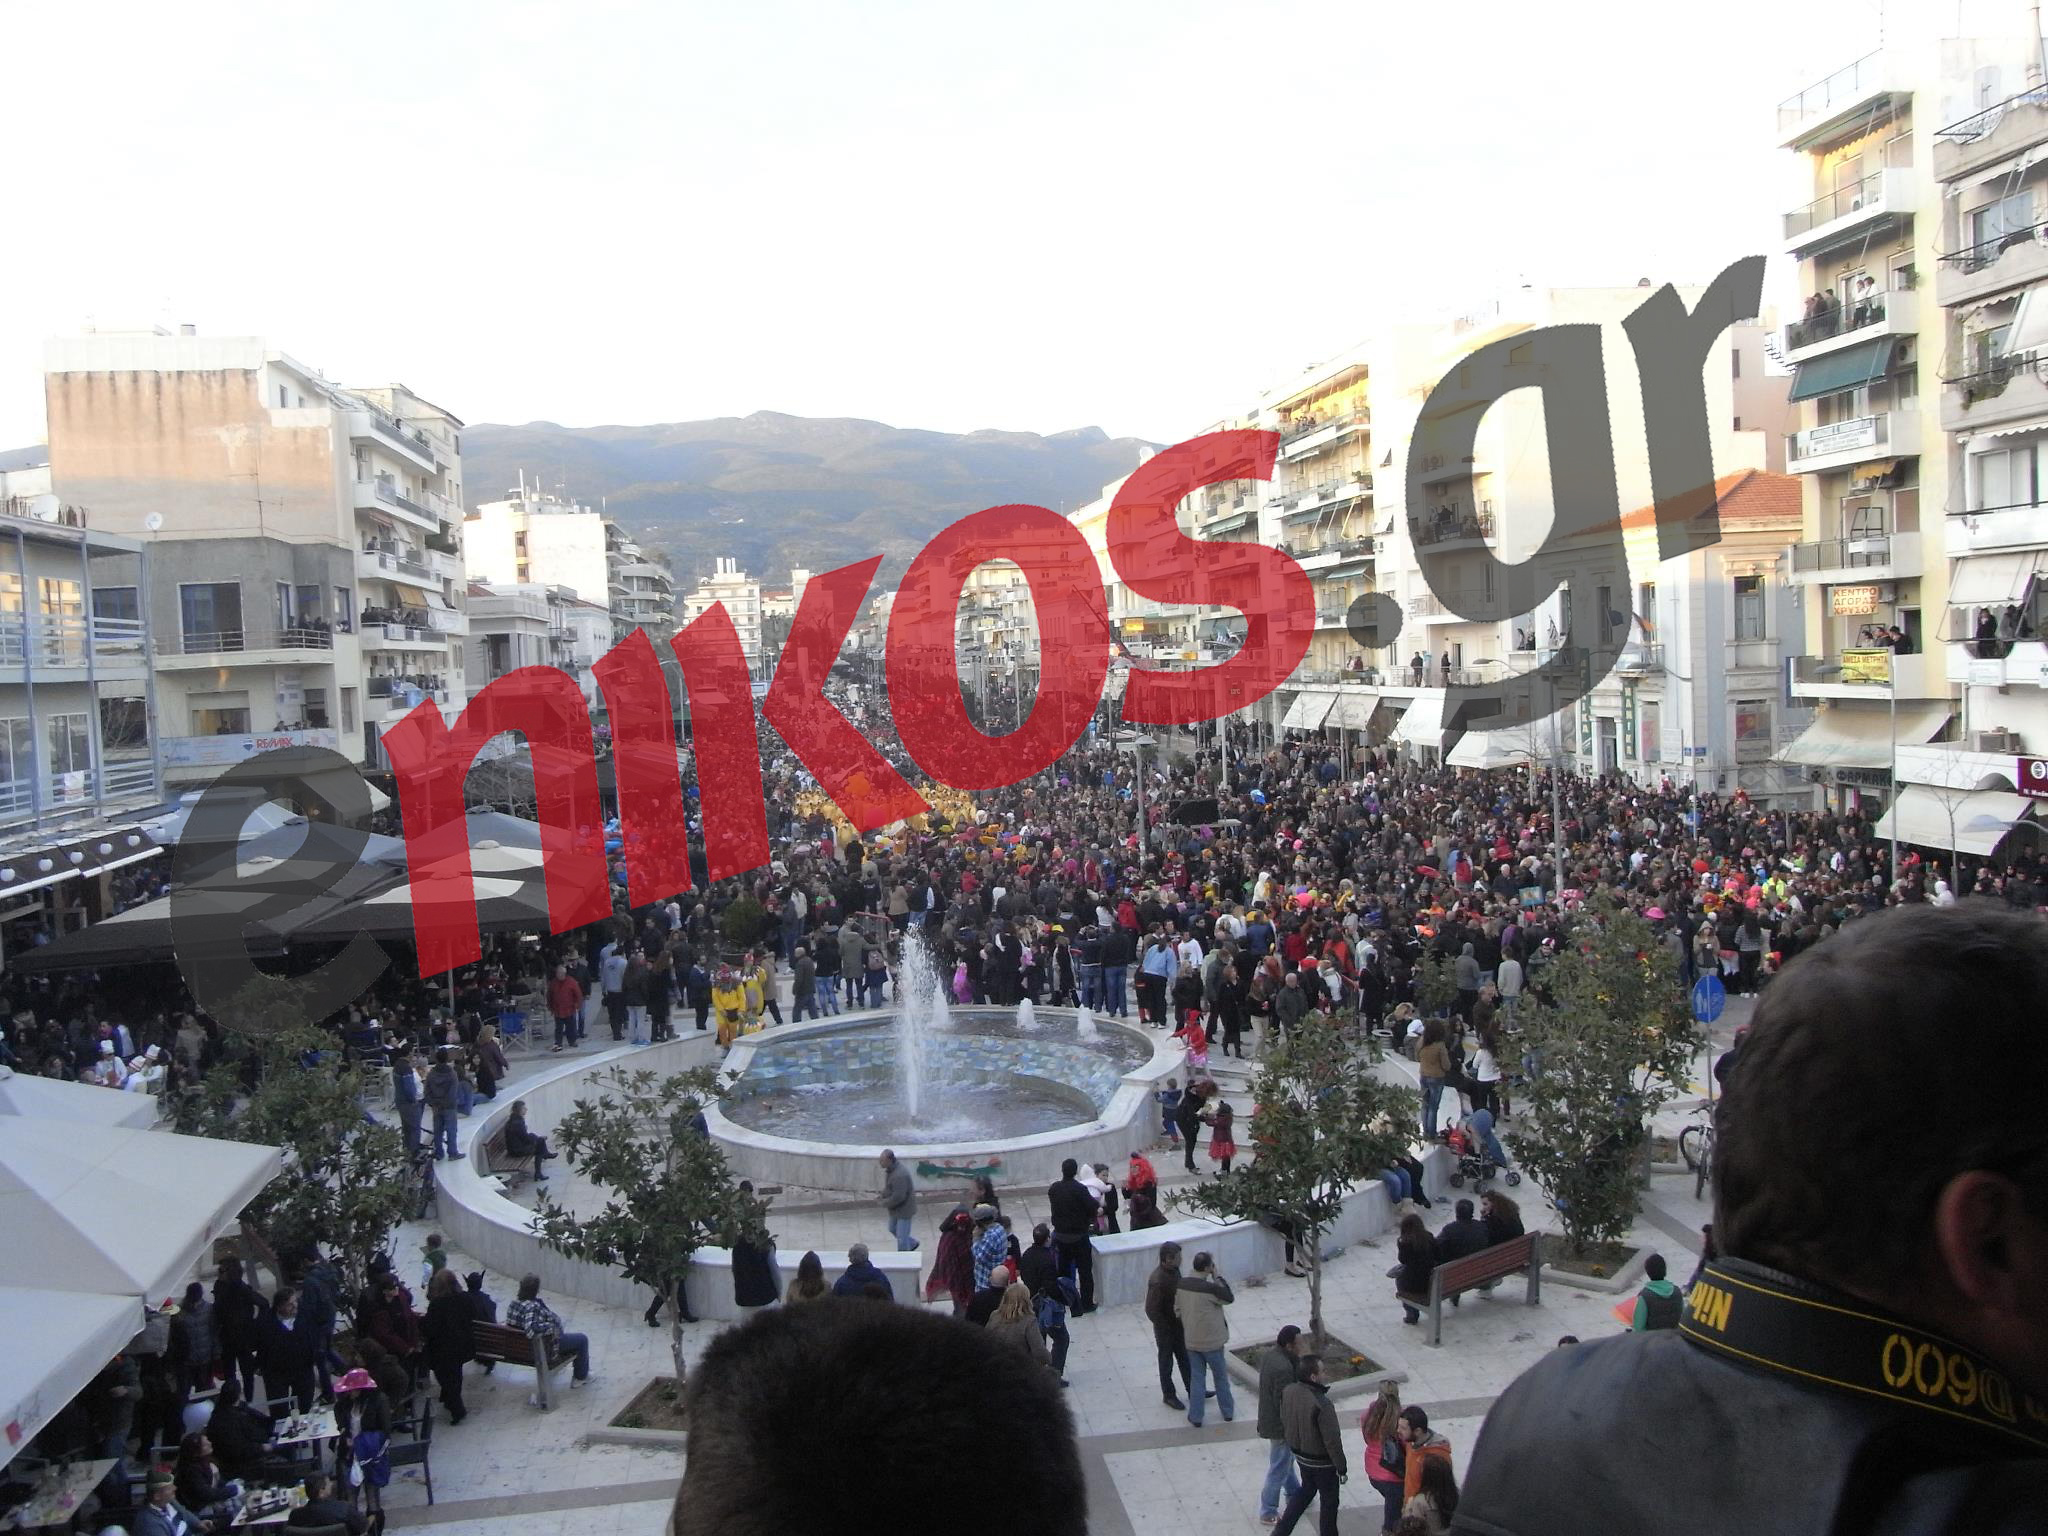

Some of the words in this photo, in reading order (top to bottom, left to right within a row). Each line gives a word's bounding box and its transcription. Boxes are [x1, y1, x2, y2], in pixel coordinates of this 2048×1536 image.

[1833, 587, 1877, 597] ΚΕΝΤΡΟ
[1834, 597, 1877, 606] ΑΓΟΡΑΣ
[1834, 605, 1877, 616] ΧΡΥΣΟΥ
